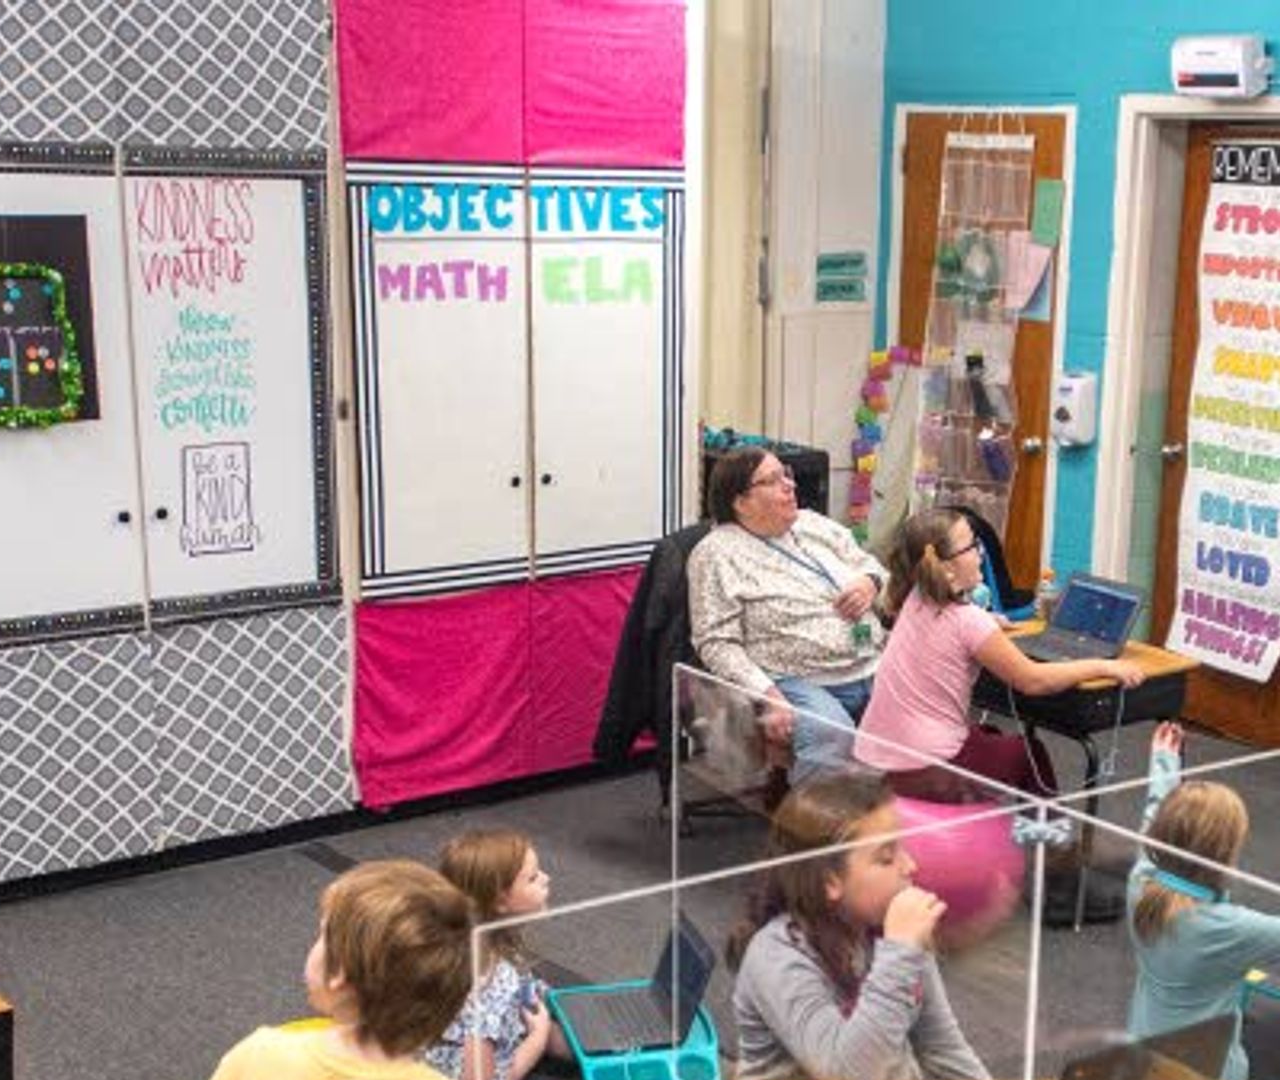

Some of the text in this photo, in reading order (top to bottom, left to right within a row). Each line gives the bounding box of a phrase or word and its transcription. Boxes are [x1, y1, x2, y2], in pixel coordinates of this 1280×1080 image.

[134, 178, 254, 244] KINDNESS
[378, 261, 509, 302] MATH
[541, 257, 654, 305] ELA
[1199, 490, 1280, 538] BRAVE
[1196, 540, 1271, 587] LOVED
